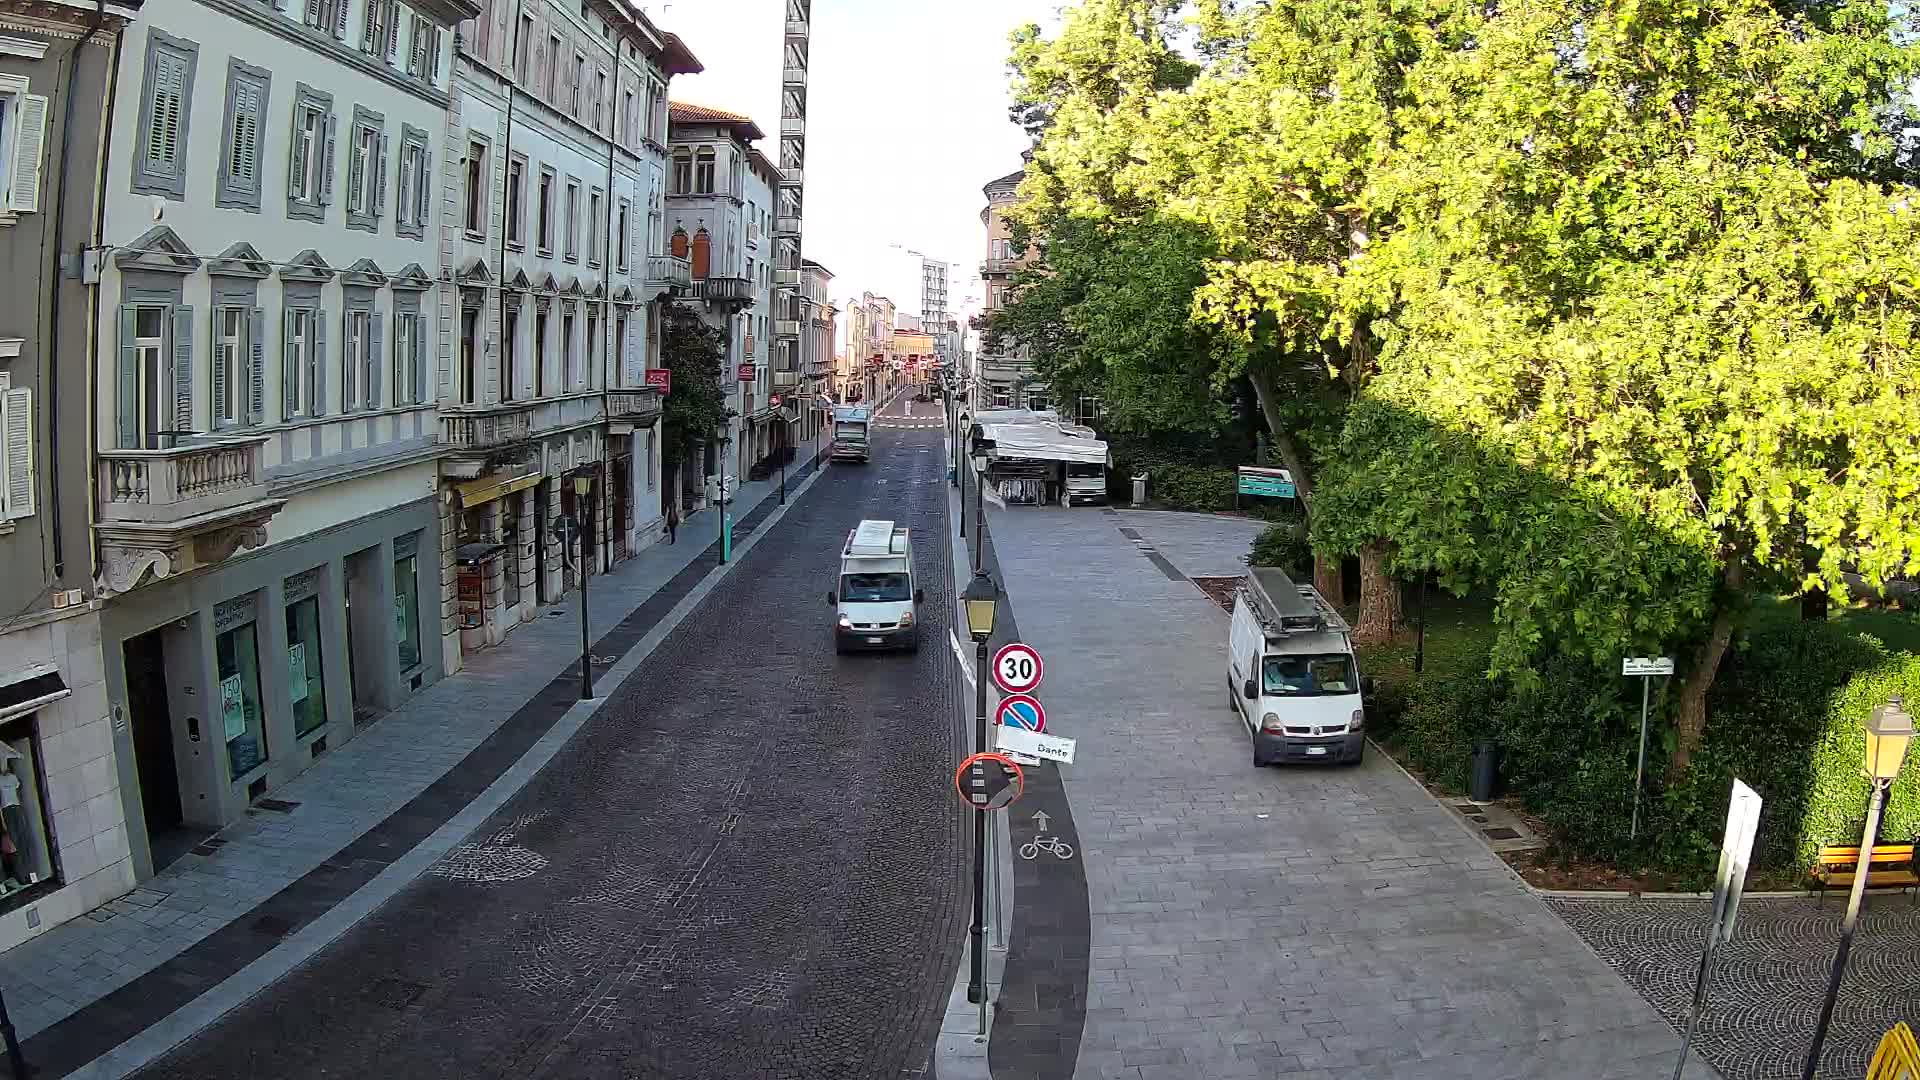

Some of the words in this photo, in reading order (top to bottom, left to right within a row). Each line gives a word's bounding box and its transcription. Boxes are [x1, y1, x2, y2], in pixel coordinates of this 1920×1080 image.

[1005, 657, 1033, 680] 30
[222, 677, 240, 698] 130
[1037, 743, 1068, 759] Dante
